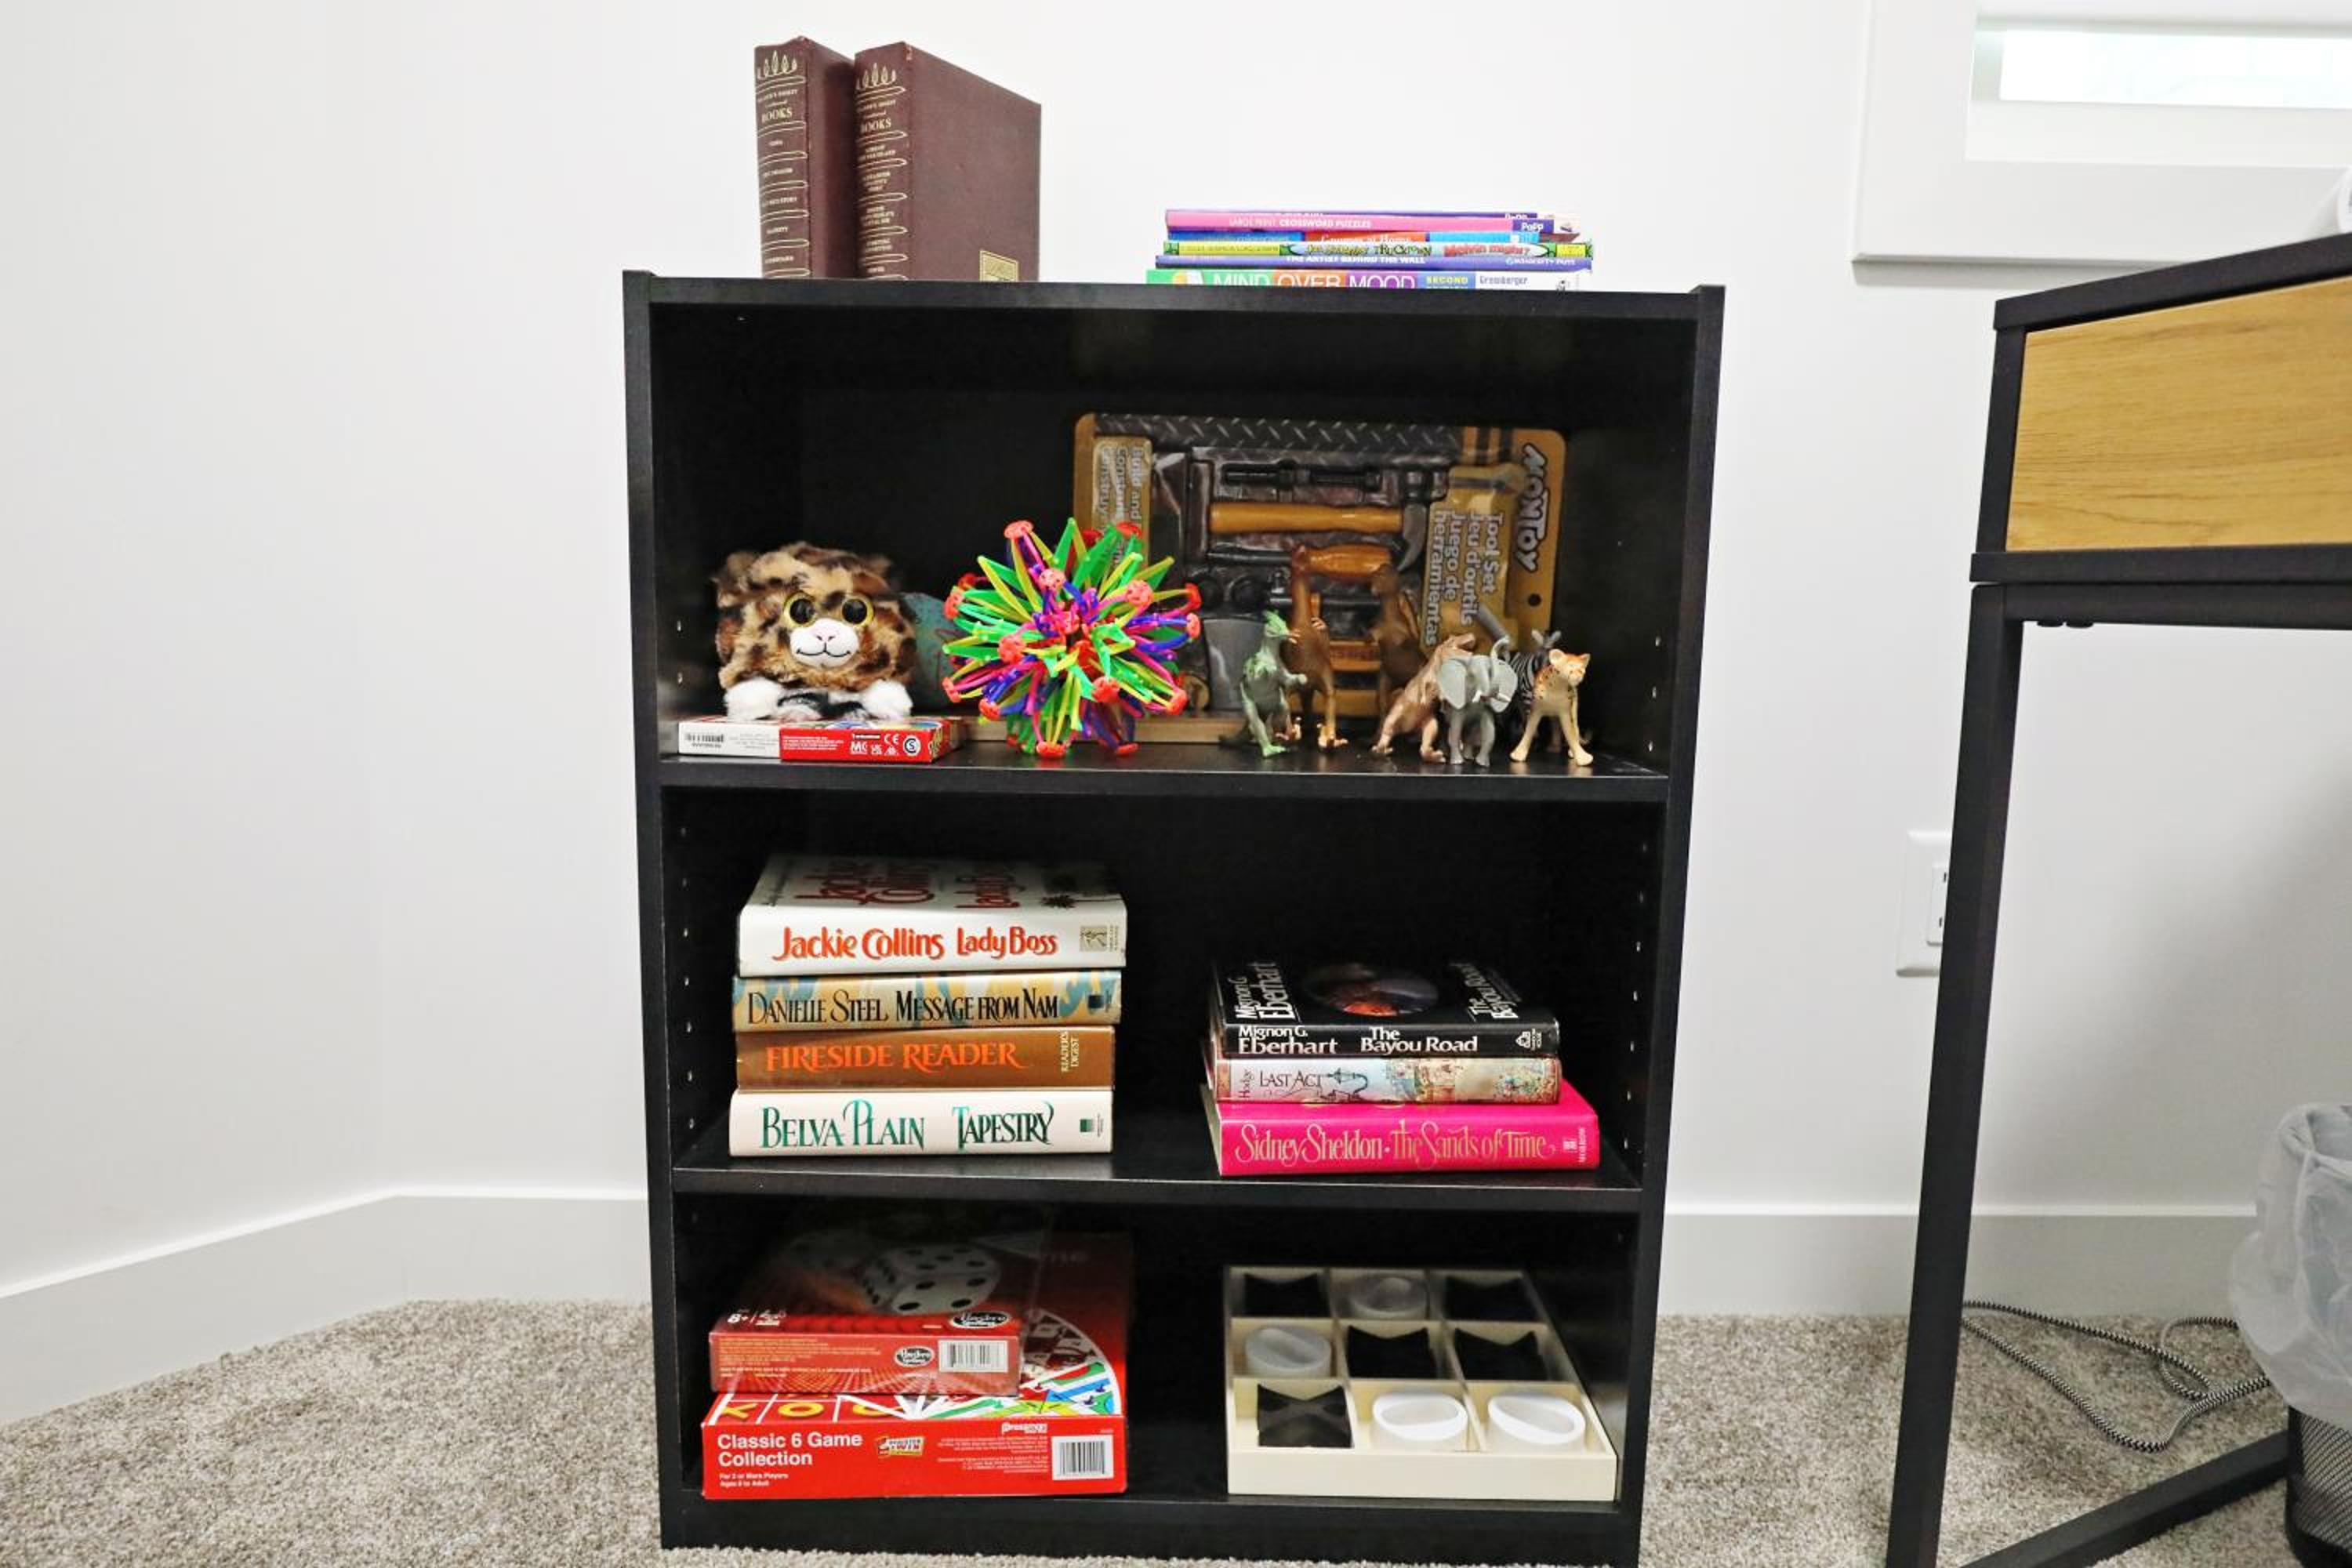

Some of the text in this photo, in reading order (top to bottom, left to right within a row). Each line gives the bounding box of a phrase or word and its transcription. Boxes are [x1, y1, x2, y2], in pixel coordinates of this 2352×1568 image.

[1279, 218, 1333, 227] CROSSWORD
[1335, 219, 1371, 228] PUZZLES
[1214, 274, 1415, 288] MIND OVER MOOD
[1426, 275, 1468, 284] SECOND
[1131, 491, 1142, 520] and
[1444, 513, 1466, 602] Juego de
[1482, 513, 1503, 593] Tool Set
[1425, 510, 1450, 646] herramientas
[1460, 513, 1481, 626] Jeu d'outils
[771, 926, 1058, 961] Jackie Collins Lady Boss
[1233, 984, 1261, 1019] Mignon
[1248, 963, 1296, 1019] Eberhart
[1477, 988, 1519, 1018] Bayou
[747, 987, 1058, 1025] DANIELLE STEEL MESSAGE FROM NAM
[1468, 997, 1490, 1015] The
[1238, 1025, 1308, 1040] Mignon G.
[1238, 1036, 1339, 1054] Eberhart
[1360, 1036, 1478, 1054] Bayou Road
[1369, 1026, 1400, 1041] The
[764, 1041, 1032, 1075] FIRESIDE READER
[1070, 1037, 1080, 1067] DIGEST
[1259, 1070, 1323, 1088] LAST ACT
[761, 1106, 846, 1149] BELVA
[842, 1099, 925, 1151] PLAIN
[951, 1100, 1055, 1149] TAPESTRY
[1235, 1123, 1305, 1167] Sidney
[1301, 1123, 1383, 1163] Sheldon
[1416, 1120, 1478, 1171] Sands
[1481, 1129, 1503, 1160] of
[1501, 1131, 1556, 1159] Time
[717, 1432, 863, 1450] Classic 6 Game
[718, 1451, 813, 1467] Collection
[720, 1479, 737, 1488] Ages
[764, 1472, 789, 1481] Players
